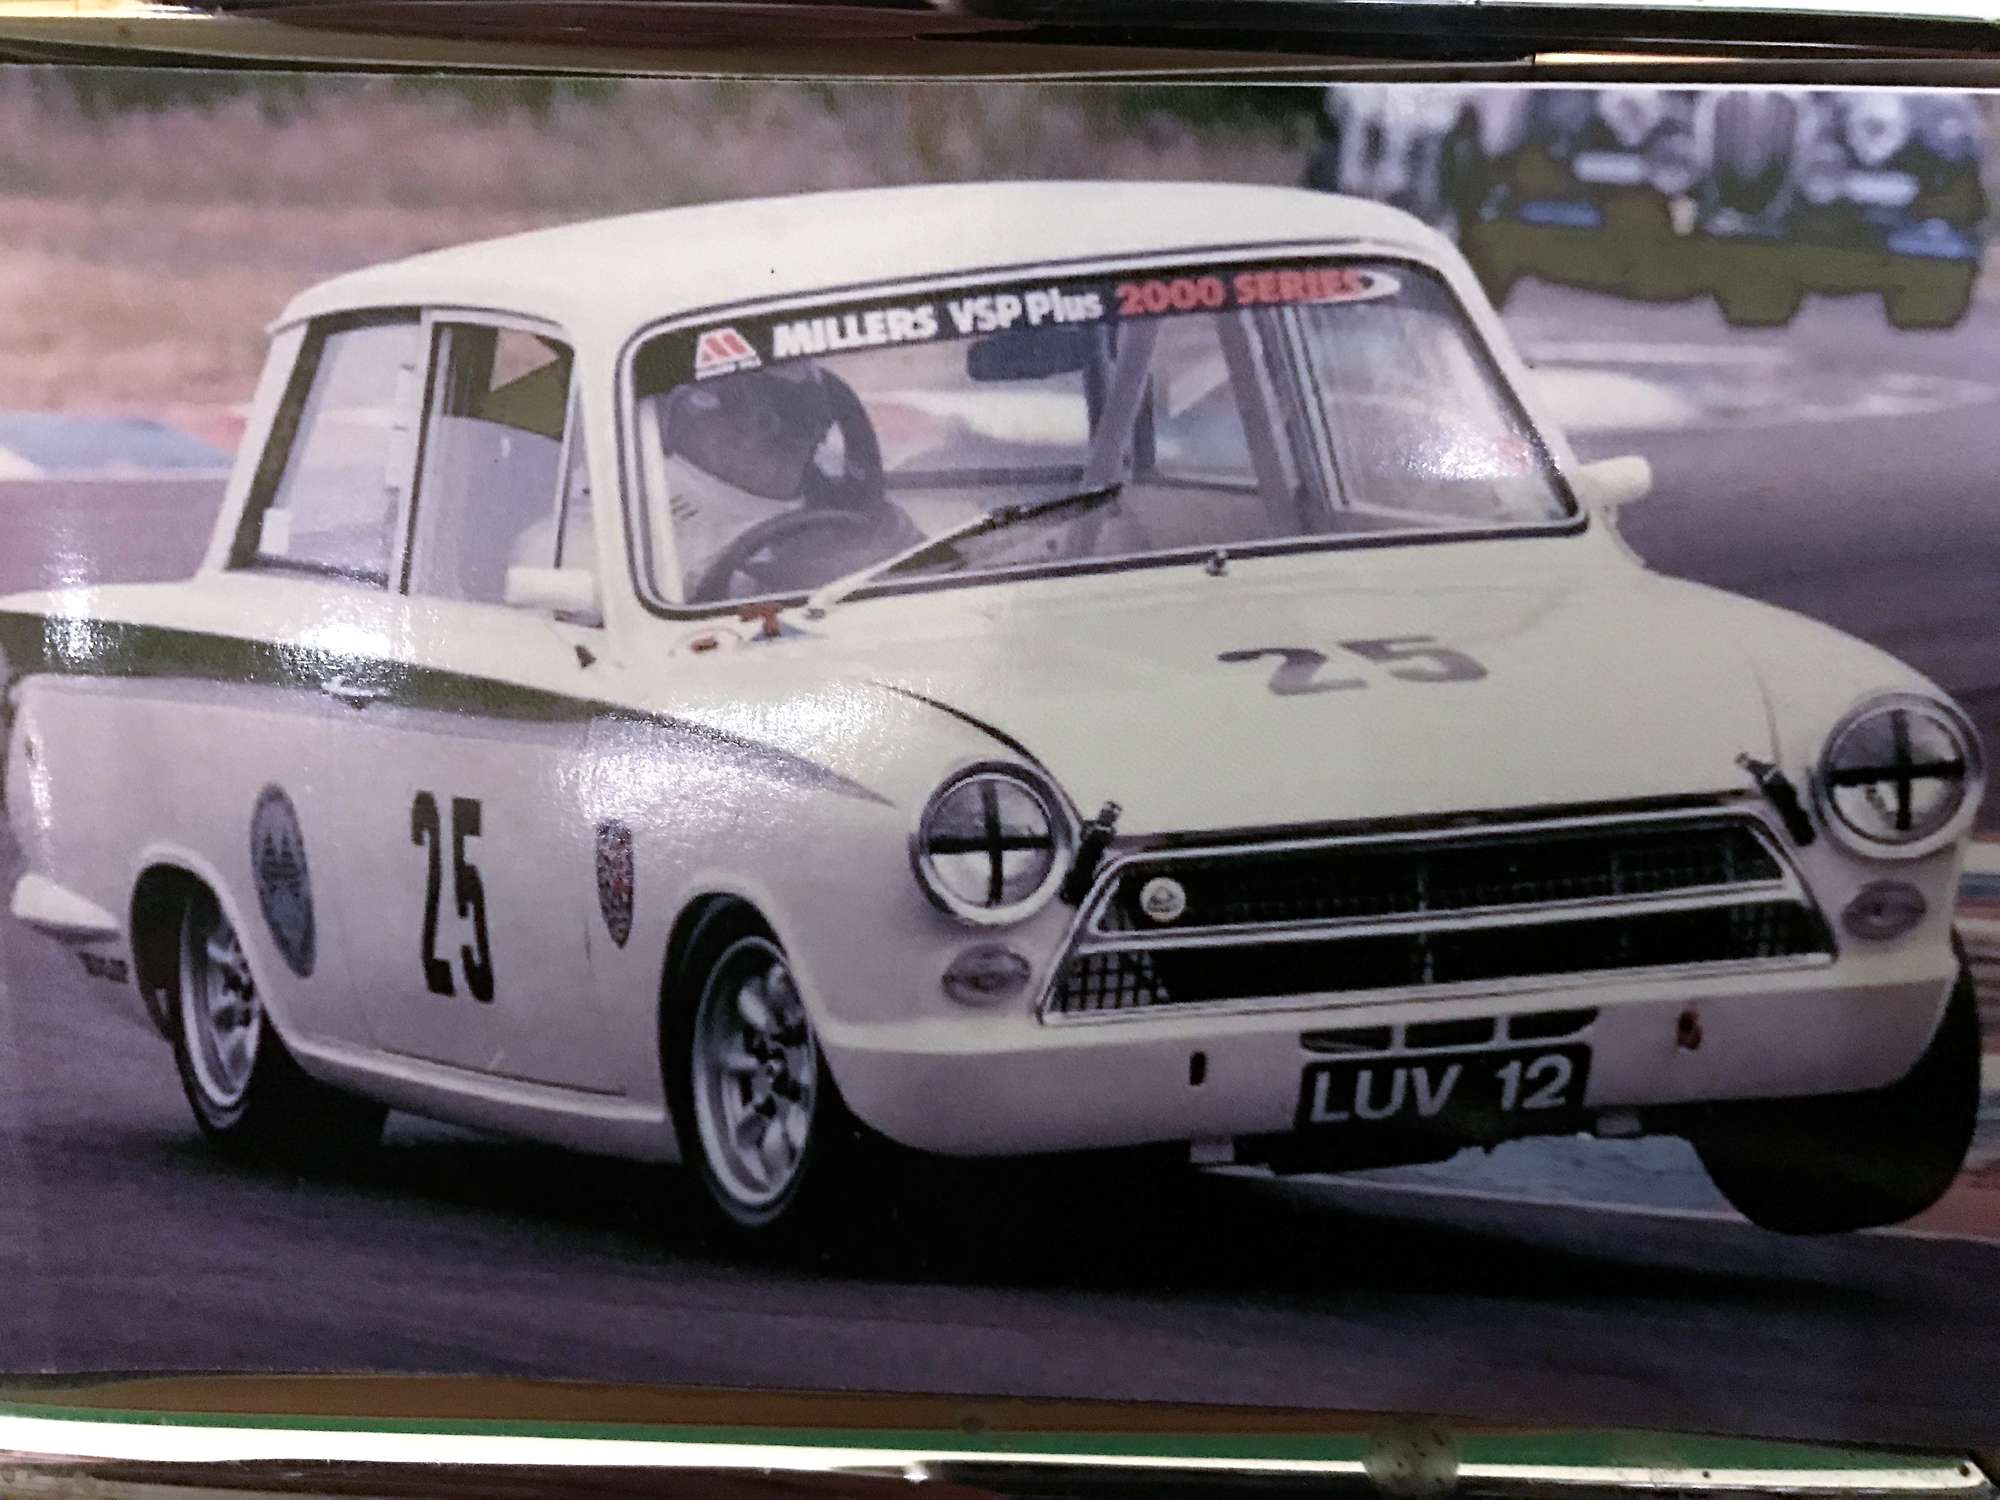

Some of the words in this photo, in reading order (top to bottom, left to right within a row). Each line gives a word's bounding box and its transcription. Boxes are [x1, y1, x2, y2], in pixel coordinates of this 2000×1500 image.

[772, 304, 938, 358] MILLERS
[947, 294, 1022, 334] VSP
[1024, 286, 1104, 327] Plus
[1115, 275, 1225, 315] 2000
[1233, 269, 1363, 305] SERIES
[1217, 635, 1488, 696] 25
[411, 790, 494, 1003] 25
[1310, 1063, 1463, 1123] LUV
[1494, 1053, 1574, 1112] 12
